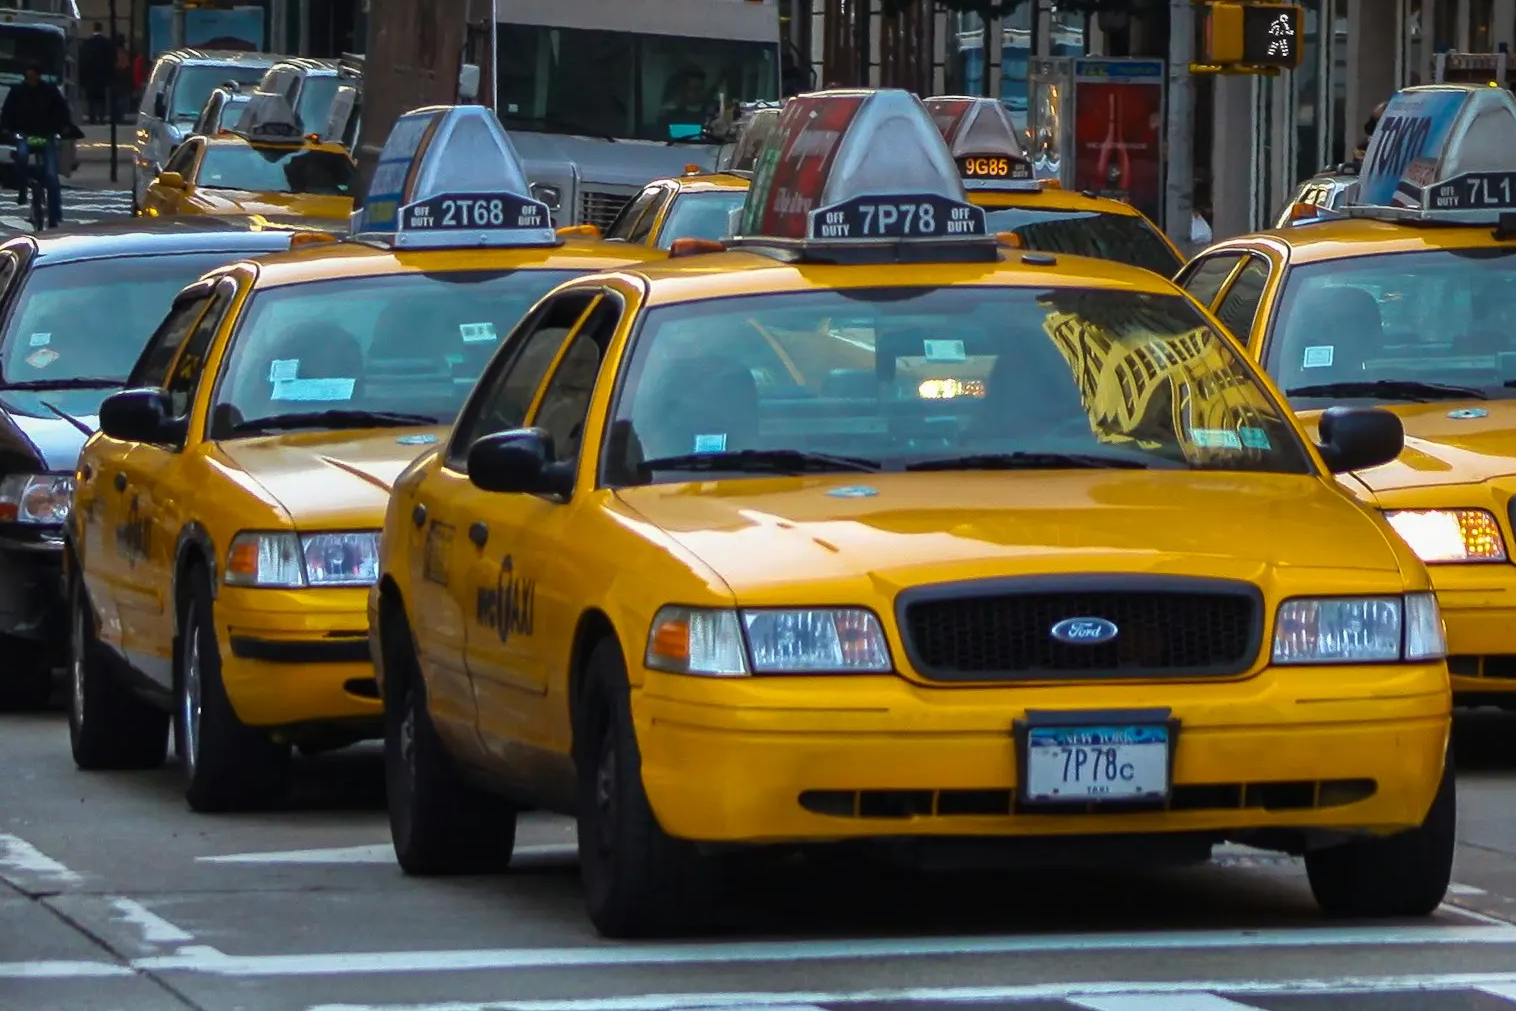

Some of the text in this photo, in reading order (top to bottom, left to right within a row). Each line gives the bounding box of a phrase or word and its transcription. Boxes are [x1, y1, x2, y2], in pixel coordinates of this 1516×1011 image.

[1368, 116, 1432, 176] TOKYO
[965, 156, 1009, 177] 9G85
[1440, 185, 1455, 196] OFF
[1437, 196, 1459, 207] DUTY
[413, 206, 431, 216] OFF
[441, 198, 504, 226] 2T68
[521, 205, 538, 215] OFF
[951, 206, 970, 220] OFF
[410, 217, 434, 227] DUTY
[517, 215, 542, 226] DUTY
[825, 211, 845, 224] OFF
[859, 202, 936, 235] 7P78
[821, 224, 851, 237] DUTY
[946, 219, 976, 233] DUTY
[1067, 622, 1102, 638] Ford
